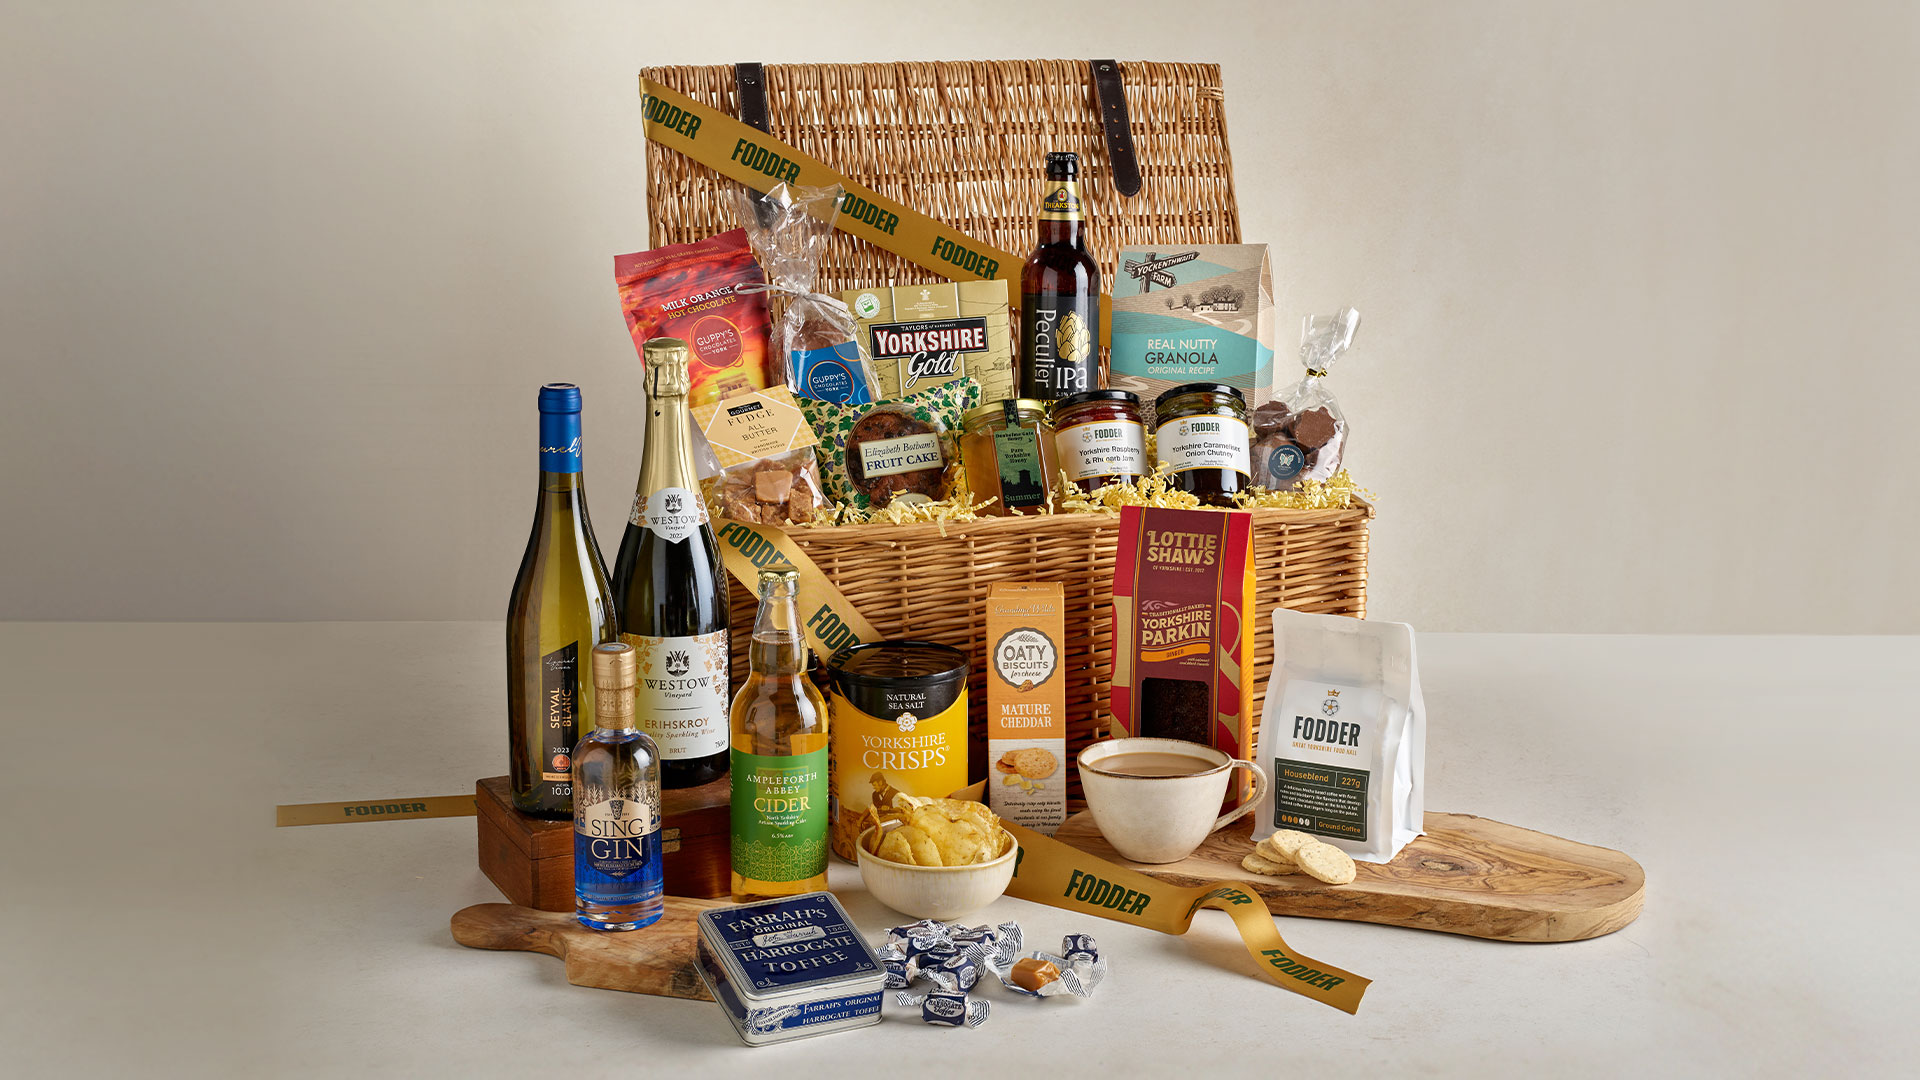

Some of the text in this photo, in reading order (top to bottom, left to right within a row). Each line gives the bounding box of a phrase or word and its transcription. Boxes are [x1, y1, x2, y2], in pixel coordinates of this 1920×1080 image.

[642, 93, 702, 140] FODDER
[731, 138, 800, 187] FODDER
[831, 189, 899, 236] FODDER
[931, 235, 999, 280] FODDER
[1137, 253, 1195, 275] YOCKENTHWAITE
[1153, 273, 1172, 287] FARM
[661, 286, 734, 313] MILK ORANGE
[668, 296, 737, 320] HOT CHOCOLATE
[697, 328, 734, 346] GUPPY'S
[874, 327, 984, 355] YORKSHIRE
[700, 337, 737, 352] CHOCOLATES
[712, 347, 728, 355] YORK
[1035, 310, 1056, 388] Peculier
[1148, 339, 1218, 350] REAL NUTTY
[1145, 352, 1219, 365] GRANOLA
[905, 351, 959, 389] Gold
[1148, 366, 1215, 374] ORIGINAL RECIPE
[812, 373, 846, 384] GUPPY'S
[731, 404, 761, 416] GOURMET
[728, 409, 774, 426] FUDGE
[742, 427, 778, 441] BUTTER
[1094, 428, 1123, 439] FODDER
[1191, 422, 1220, 432] FODDER
[865, 440, 936, 458] Elizabeth Botham's
[1079, 446, 1140, 457] Yorkshire Raspberry
[1172, 443, 1202, 453] Yorkshire
[1186, 450, 1234, 459] Onion Chutney
[866, 452, 939, 471] FRUIT CAKE
[1005, 493, 1040, 502] Summer
[651, 516, 697, 525] WESTOW
[1147, 530, 1218, 550] LOTTIE
[1147, 546, 1215, 566] SHAW'S
[1148, 606, 1188, 617] TRADITIONALLY
[1142, 610, 1212, 629] YORKSHIRE
[1142, 622, 1211, 646] PARKIN
[1004, 645, 1047, 661] OATY
[1166, 649, 1184, 658] GINGER
[1003, 662, 1049, 670] BISCUITS
[1011, 670, 1020, 678] for
[644, 677, 710, 691] WESTOW
[665, 691, 693, 700] Vineyard
[887, 692, 927, 702] NATURAL
[551, 687, 561, 729] SEYVAL
[562, 689, 572, 728] BLANC
[889, 702, 925, 710] SEA SALT
[1001, 704, 1052, 716] MATURE
[644, 717, 710, 729] ERIHSKROY
[1001, 716, 1052, 728] CHEDDAR
[666, 731, 699, 740] Sparkling
[1293, 716, 1361, 747] FODDER
[861, 732, 946, 749] YORKSHIRE
[1292, 741, 1306, 749] GREAT
[1307, 743, 1332, 752] YORKSHIRE
[746, 772, 817, 785] AMPLEFORTH
[1284, 768, 1361, 788] Houseblend 227g
[552, 787, 573, 796] 10.0
[766, 785, 800, 795] ABBEY
[344, 803, 428, 817] FODDER
[754, 796, 812, 813] CIDER
[591, 818, 644, 837] SING
[1319, 821, 1361, 833] Ground Coffee
[591, 837, 644, 860] GIN
[1063, 869, 1152, 917] FODDER
[728, 908, 828, 933] FARRAH'S
[754, 920, 813, 934] ORIGINAL
[827, 925, 848, 933] 1840
[742, 936, 856, 962] HARROGATE
[764, 950, 848, 973] TOFFEE
[1260, 949, 1346, 992] FODDER
[804, 1001, 842, 1015] FARRAH'S
[845, 995, 881, 1007] ORIGINAL
[802, 1005, 881, 1024] HARROGATE TOFFEE
